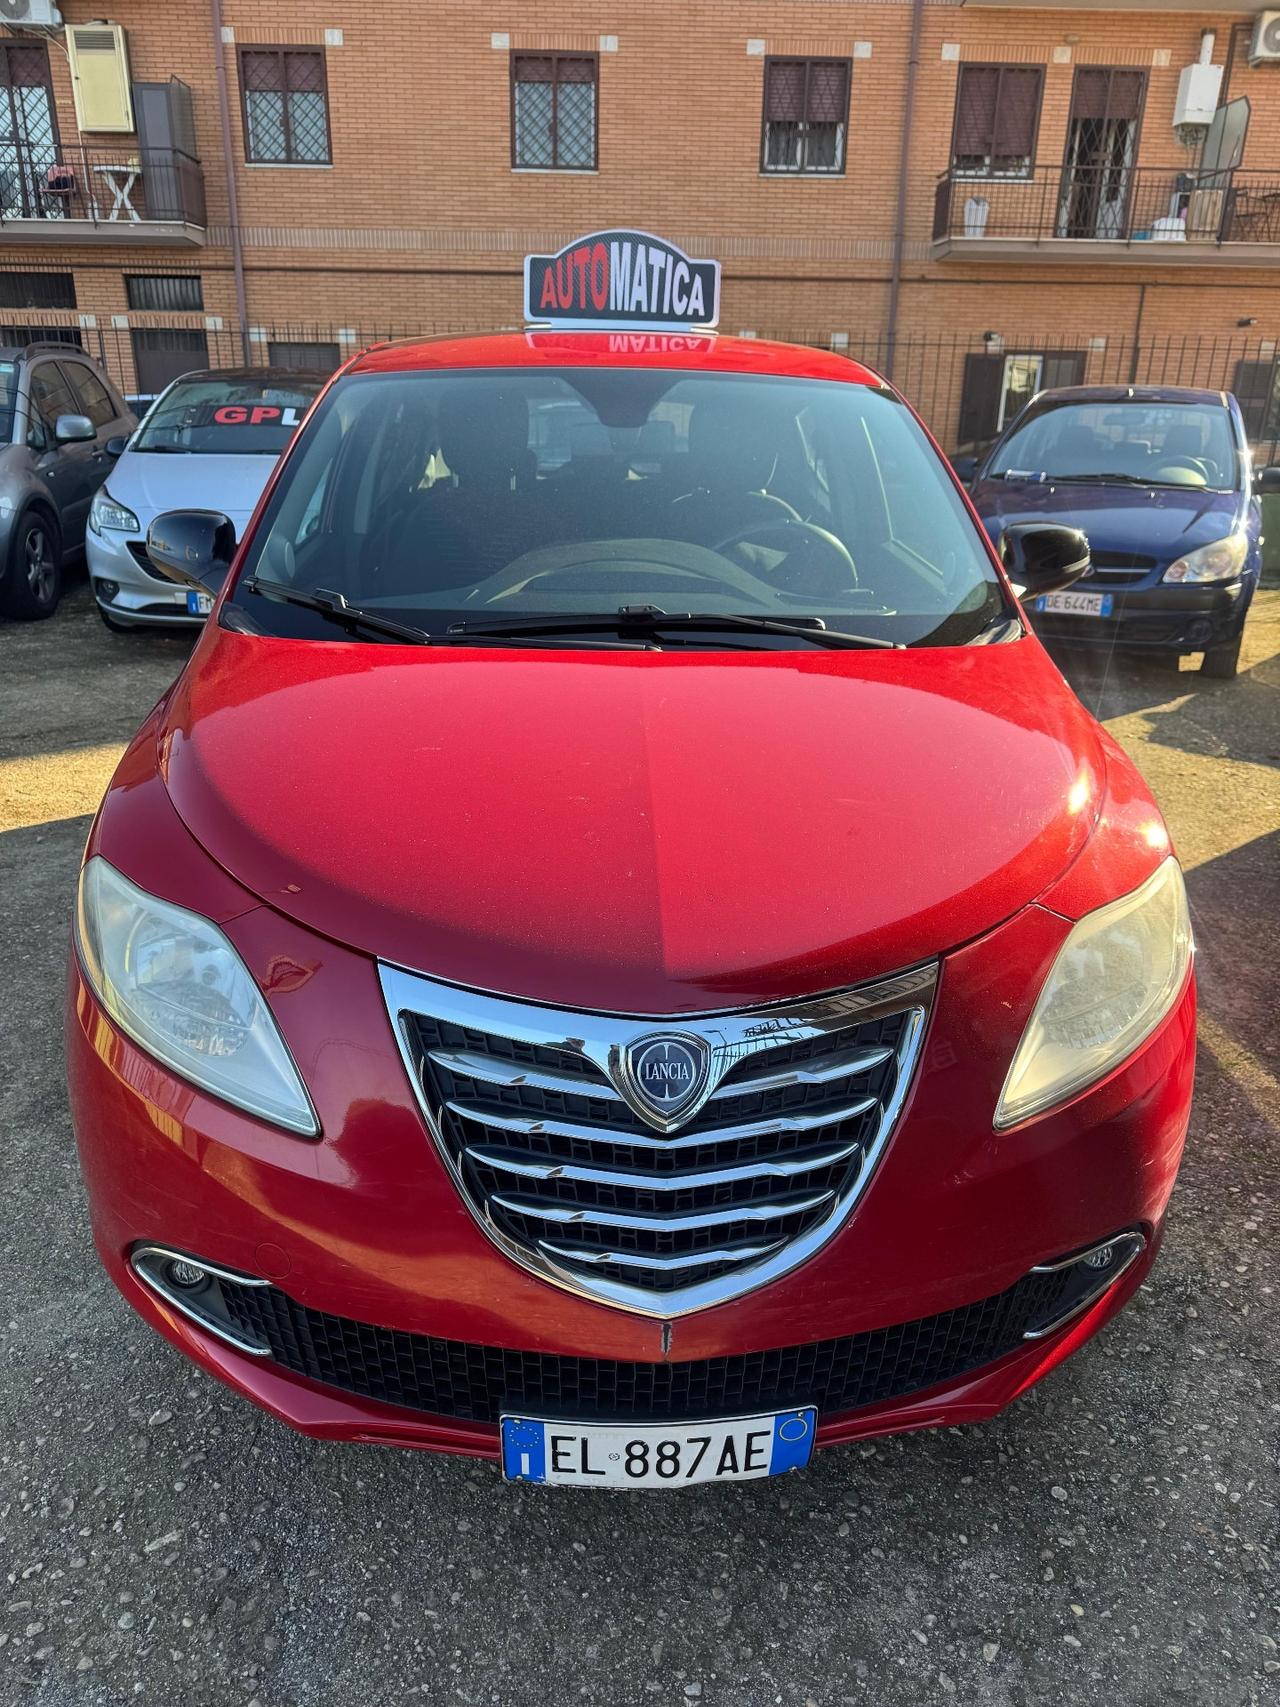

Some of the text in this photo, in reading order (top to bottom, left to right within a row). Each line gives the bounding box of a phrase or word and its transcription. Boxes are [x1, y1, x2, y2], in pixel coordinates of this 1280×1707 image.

[540, 242, 705, 316] AUTOMATICA
[214, 406, 300, 426] GPL
[645, 1062, 690, 1080] LANCIA
[551, 1430, 771, 1478] EL 887AE
